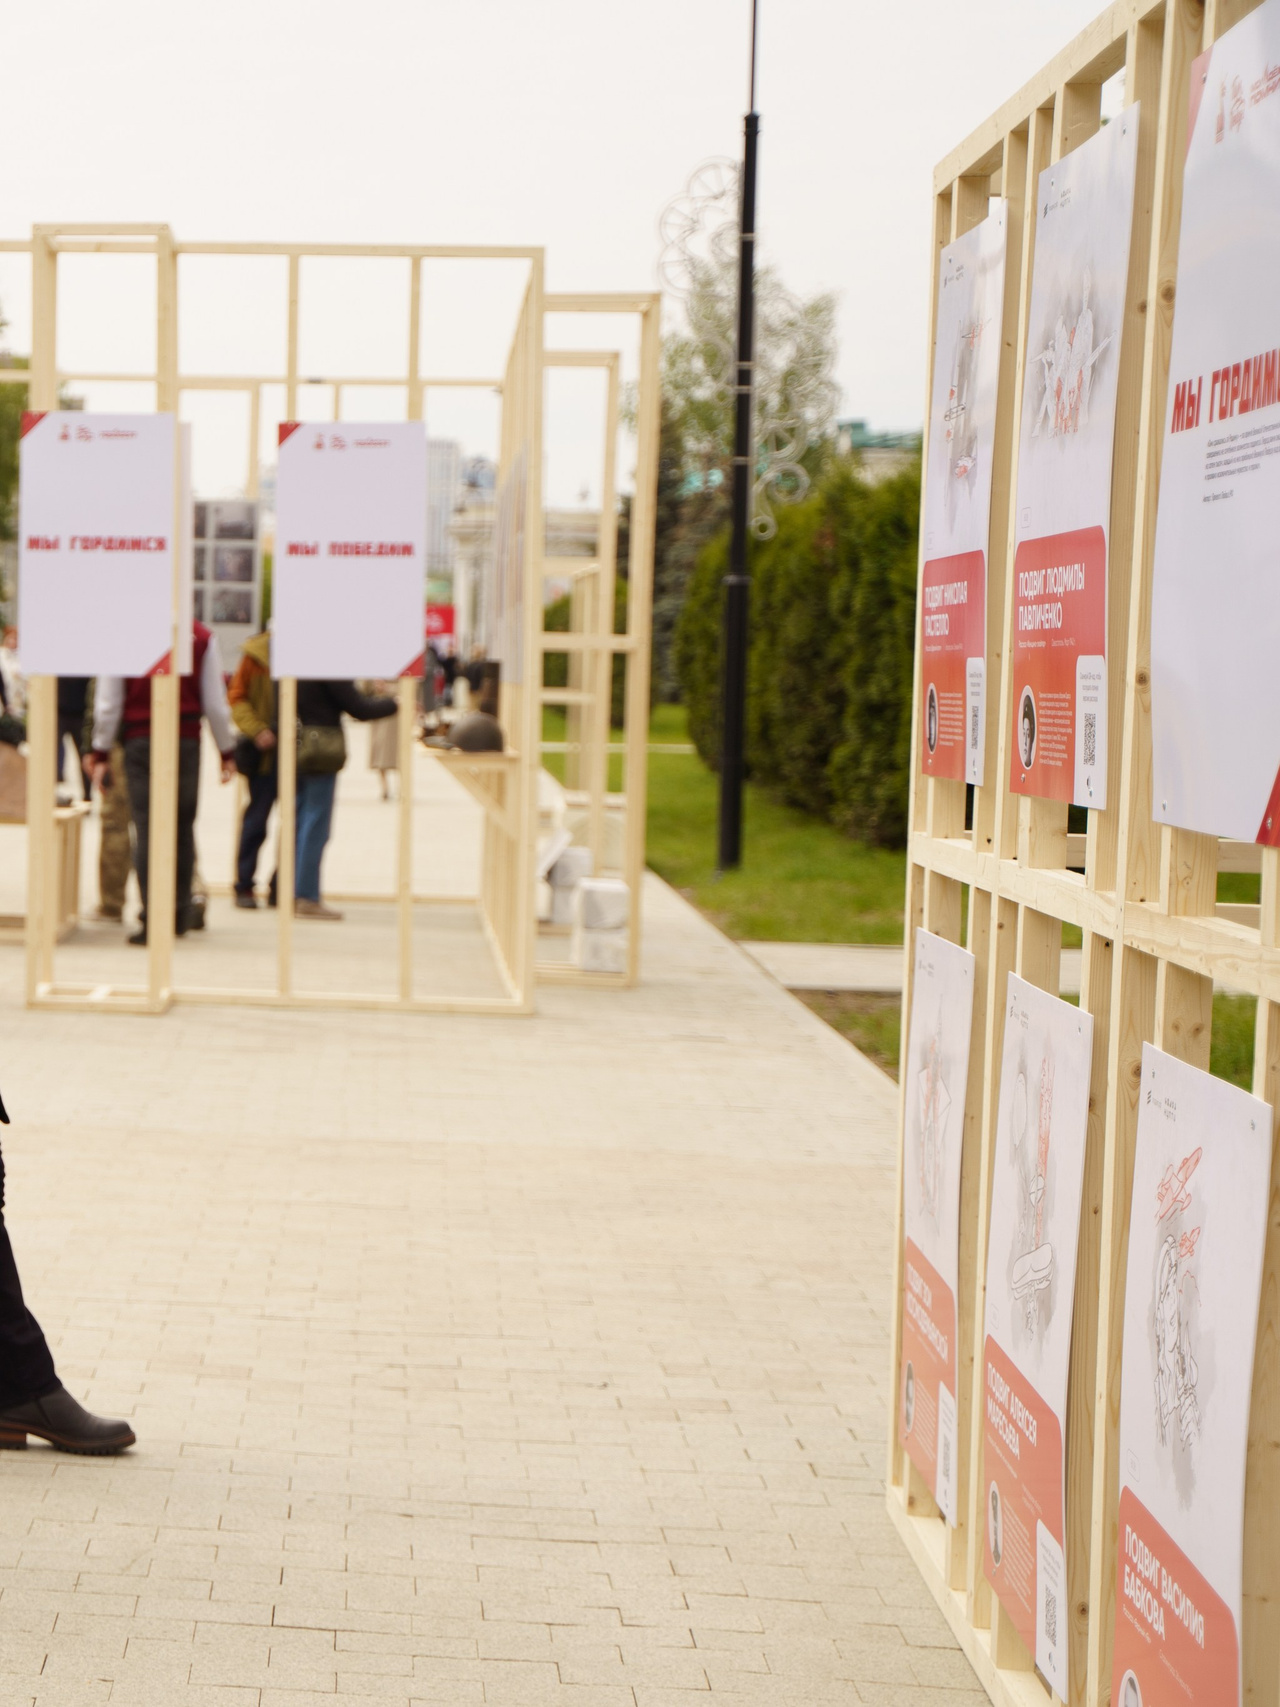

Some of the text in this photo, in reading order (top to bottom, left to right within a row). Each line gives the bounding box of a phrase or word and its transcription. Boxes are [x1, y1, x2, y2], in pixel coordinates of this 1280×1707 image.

[1171, 349, 1280, 434] МЫ ГОРДИМ
[27, 536, 166, 551] МЫ ГОРДИМСЯ
[287, 542, 414, 556] МЫ ПОБЕДИМ
[1019, 563, 1085, 600] ПОДВИГ ЛЮДМИЛЫ
[1019, 602, 1062, 631] ПАВЛИЧЕНКО
[987, 1362, 1010, 1410] ПОДВИГ
[1010, 1391, 1037, 1448] АЛЕКСЕЯ
[987, 1394, 1020, 1461] МАРЕСЬЕВА
[1124, 1564, 1166, 1641] БАБКОВА
[1125, 1524, 1160, 1590] ПОДВИГ
[1161, 1566, 1205, 1649] ВАСИЛИЯ
